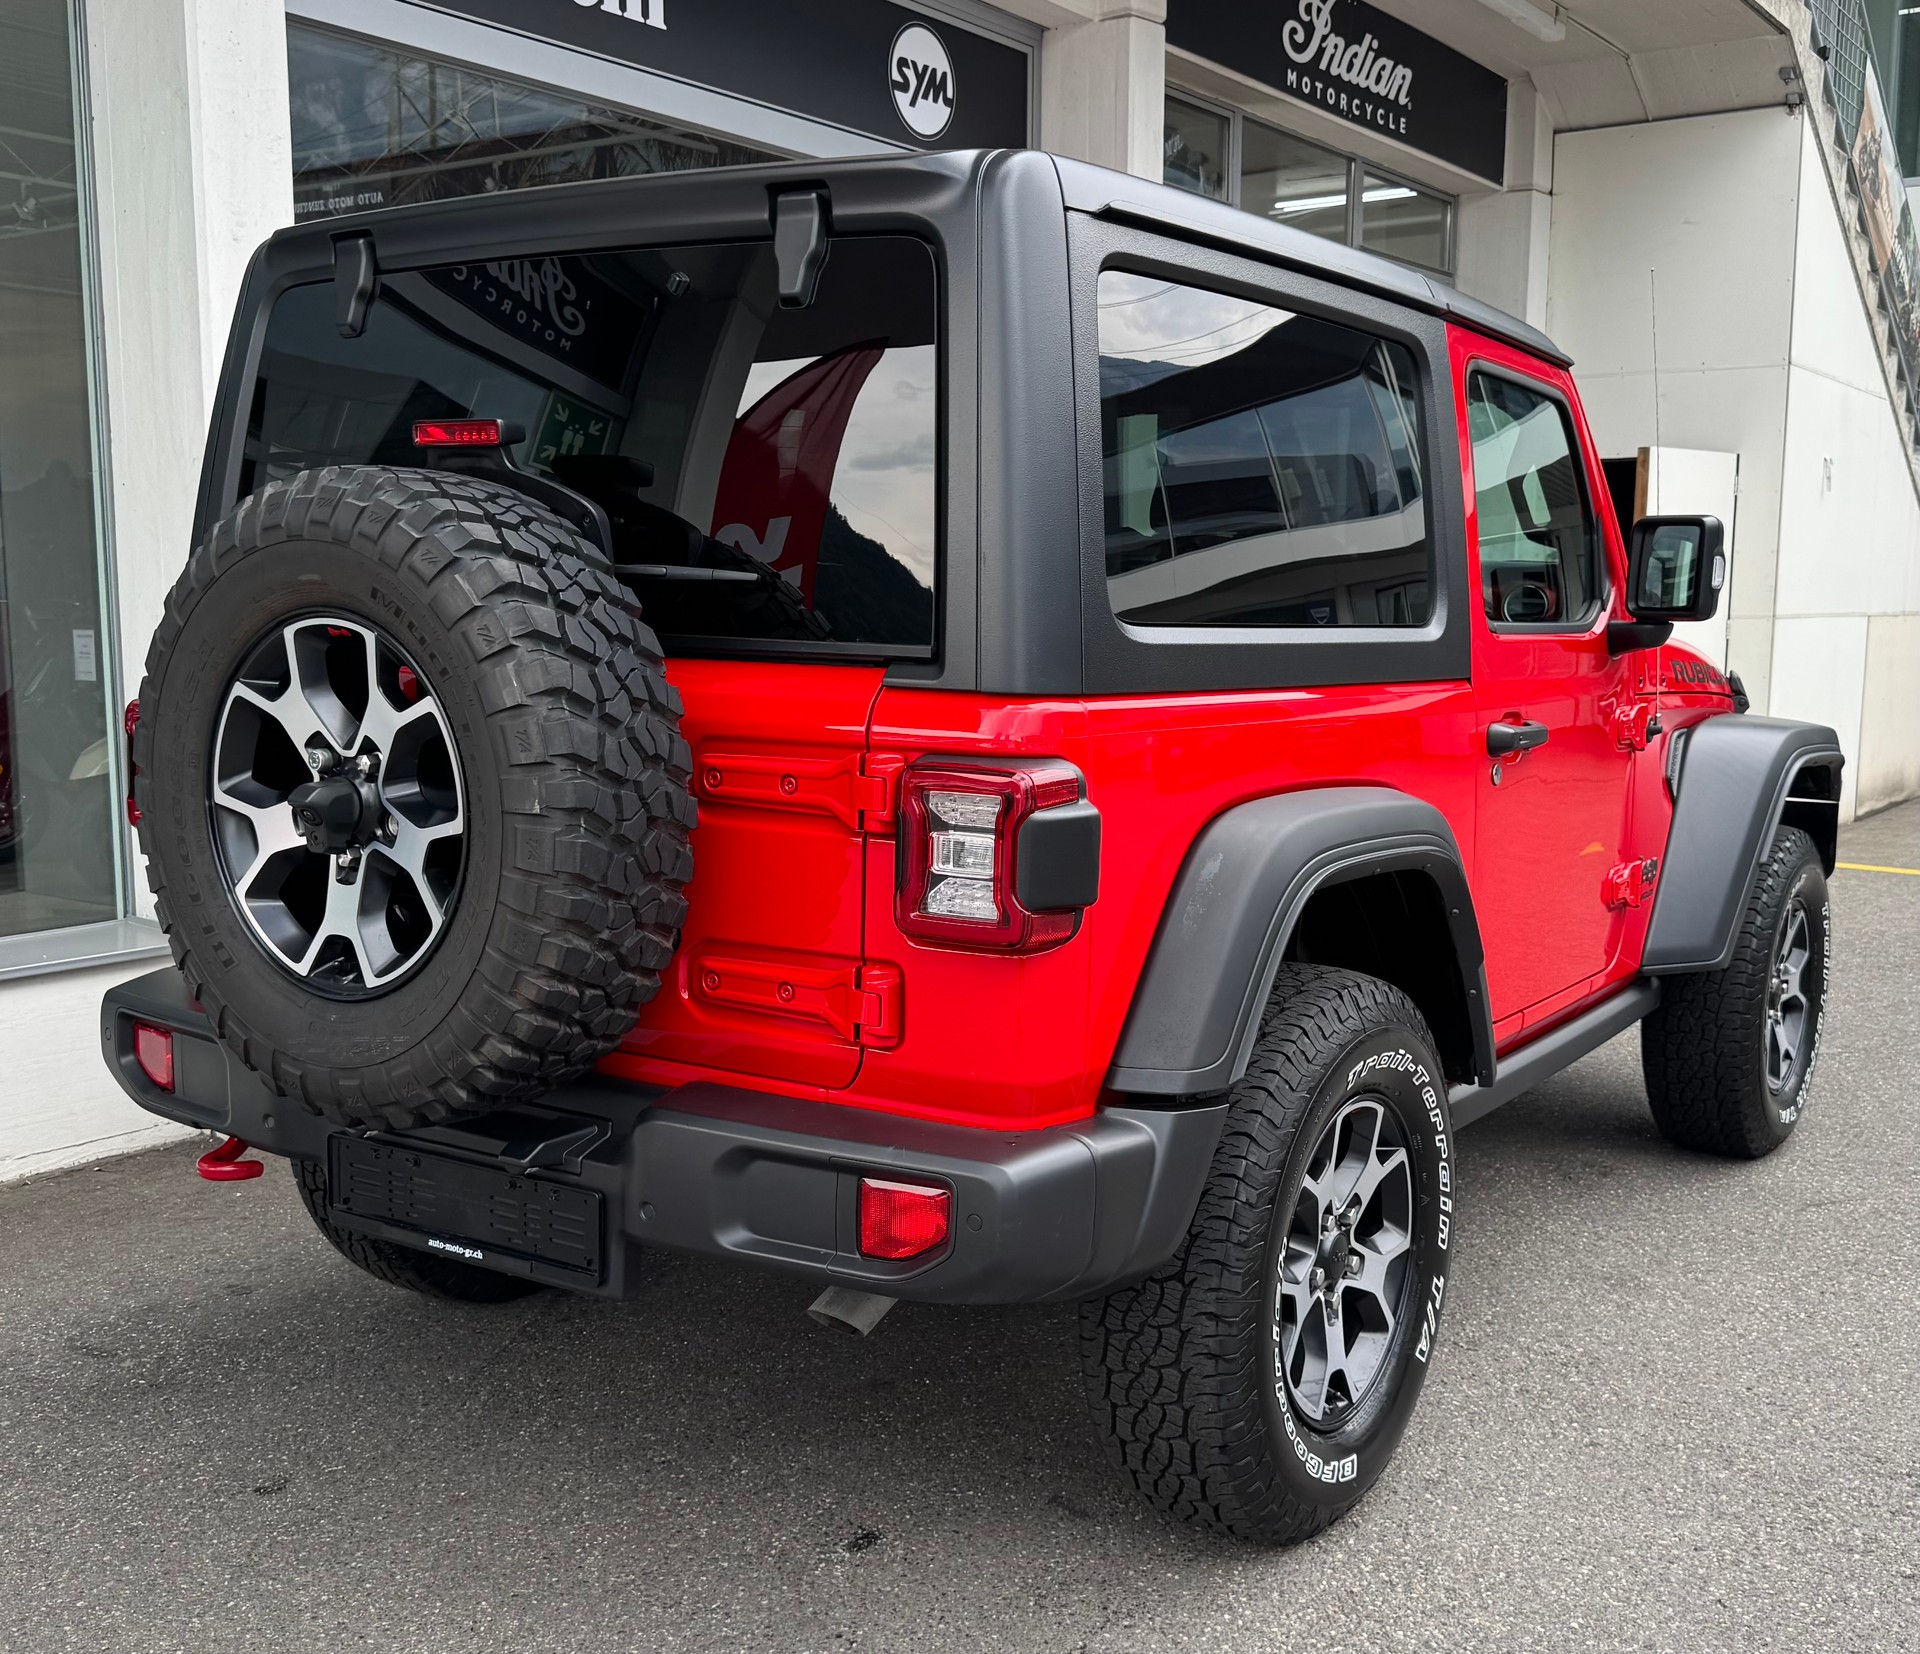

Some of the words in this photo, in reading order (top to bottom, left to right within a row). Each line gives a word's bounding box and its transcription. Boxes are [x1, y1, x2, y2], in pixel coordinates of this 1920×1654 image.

[892, 56, 954, 109] SYM
[1282, 0, 1413, 106] Indian
[1287, 68, 1407, 134] MOTORCYCLE
[1347, 1048, 1453, 1250] Trail-Terrain
[1415, 1275, 1445, 1363] T/A
[428, 1238, 483, 1260] auto-moto-gr.ch
